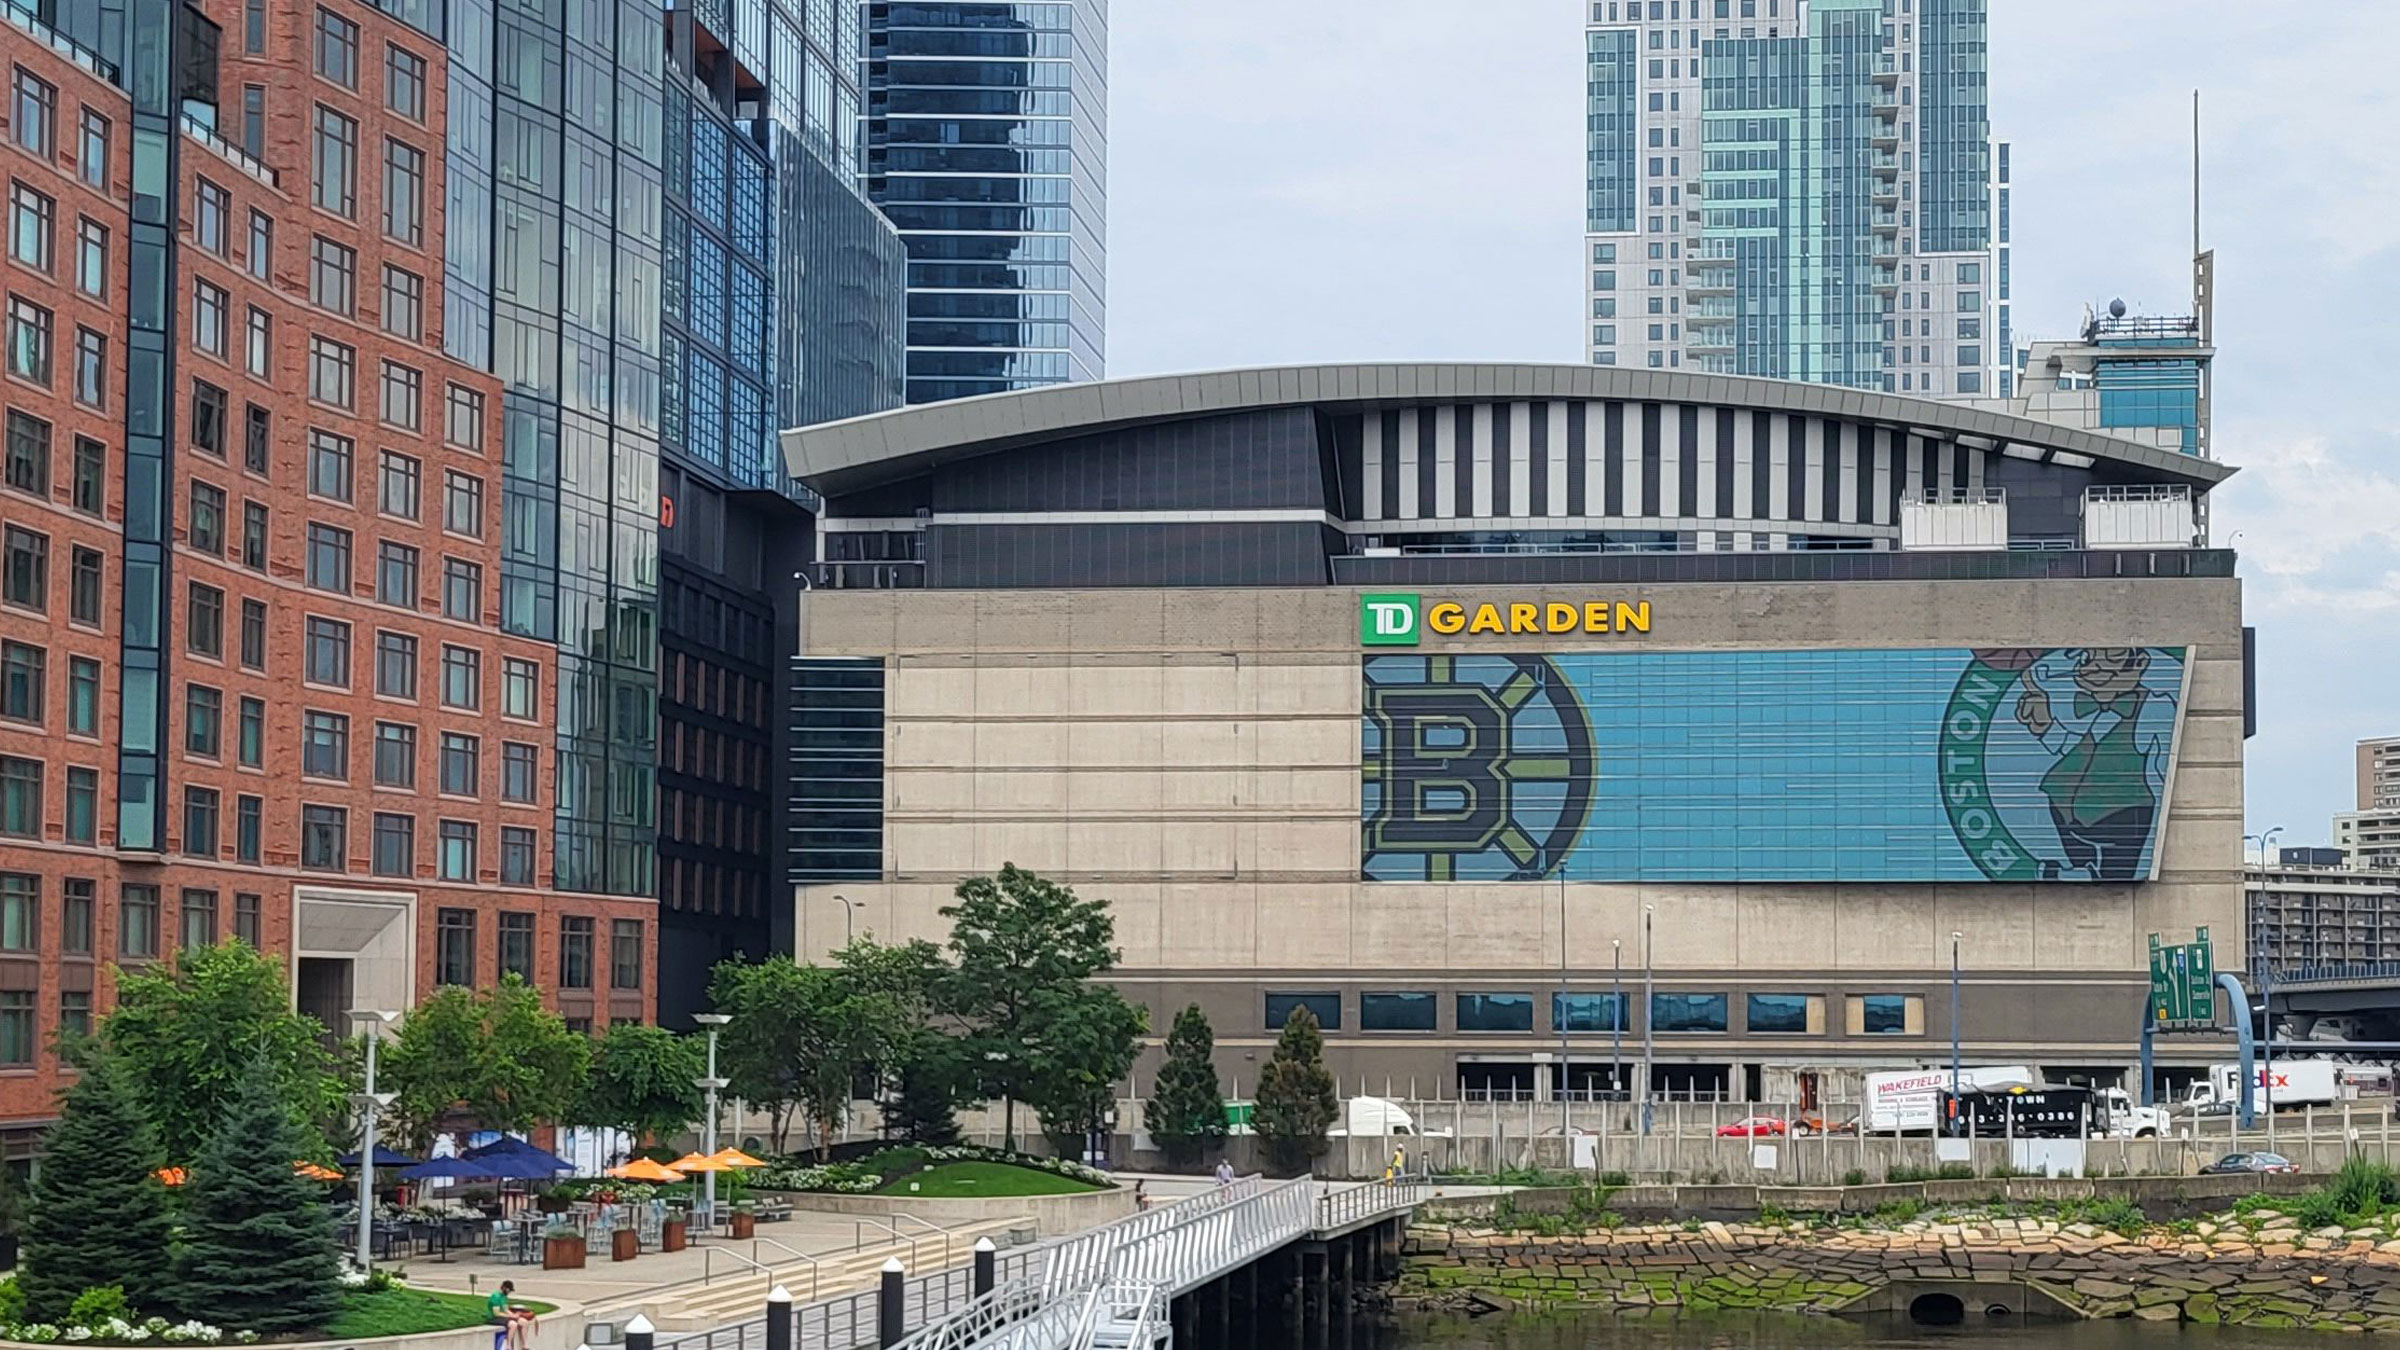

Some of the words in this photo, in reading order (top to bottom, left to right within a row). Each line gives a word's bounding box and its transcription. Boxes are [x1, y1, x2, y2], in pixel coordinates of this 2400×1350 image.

[1367, 603, 1413, 635] TD
[1429, 602, 1650, 634] GARDEN
[1375, 688, 1508, 849] B
[1947, 673, 2021, 876] BOSTON
[1877, 1074, 1942, 1093] WAKEFIELD
